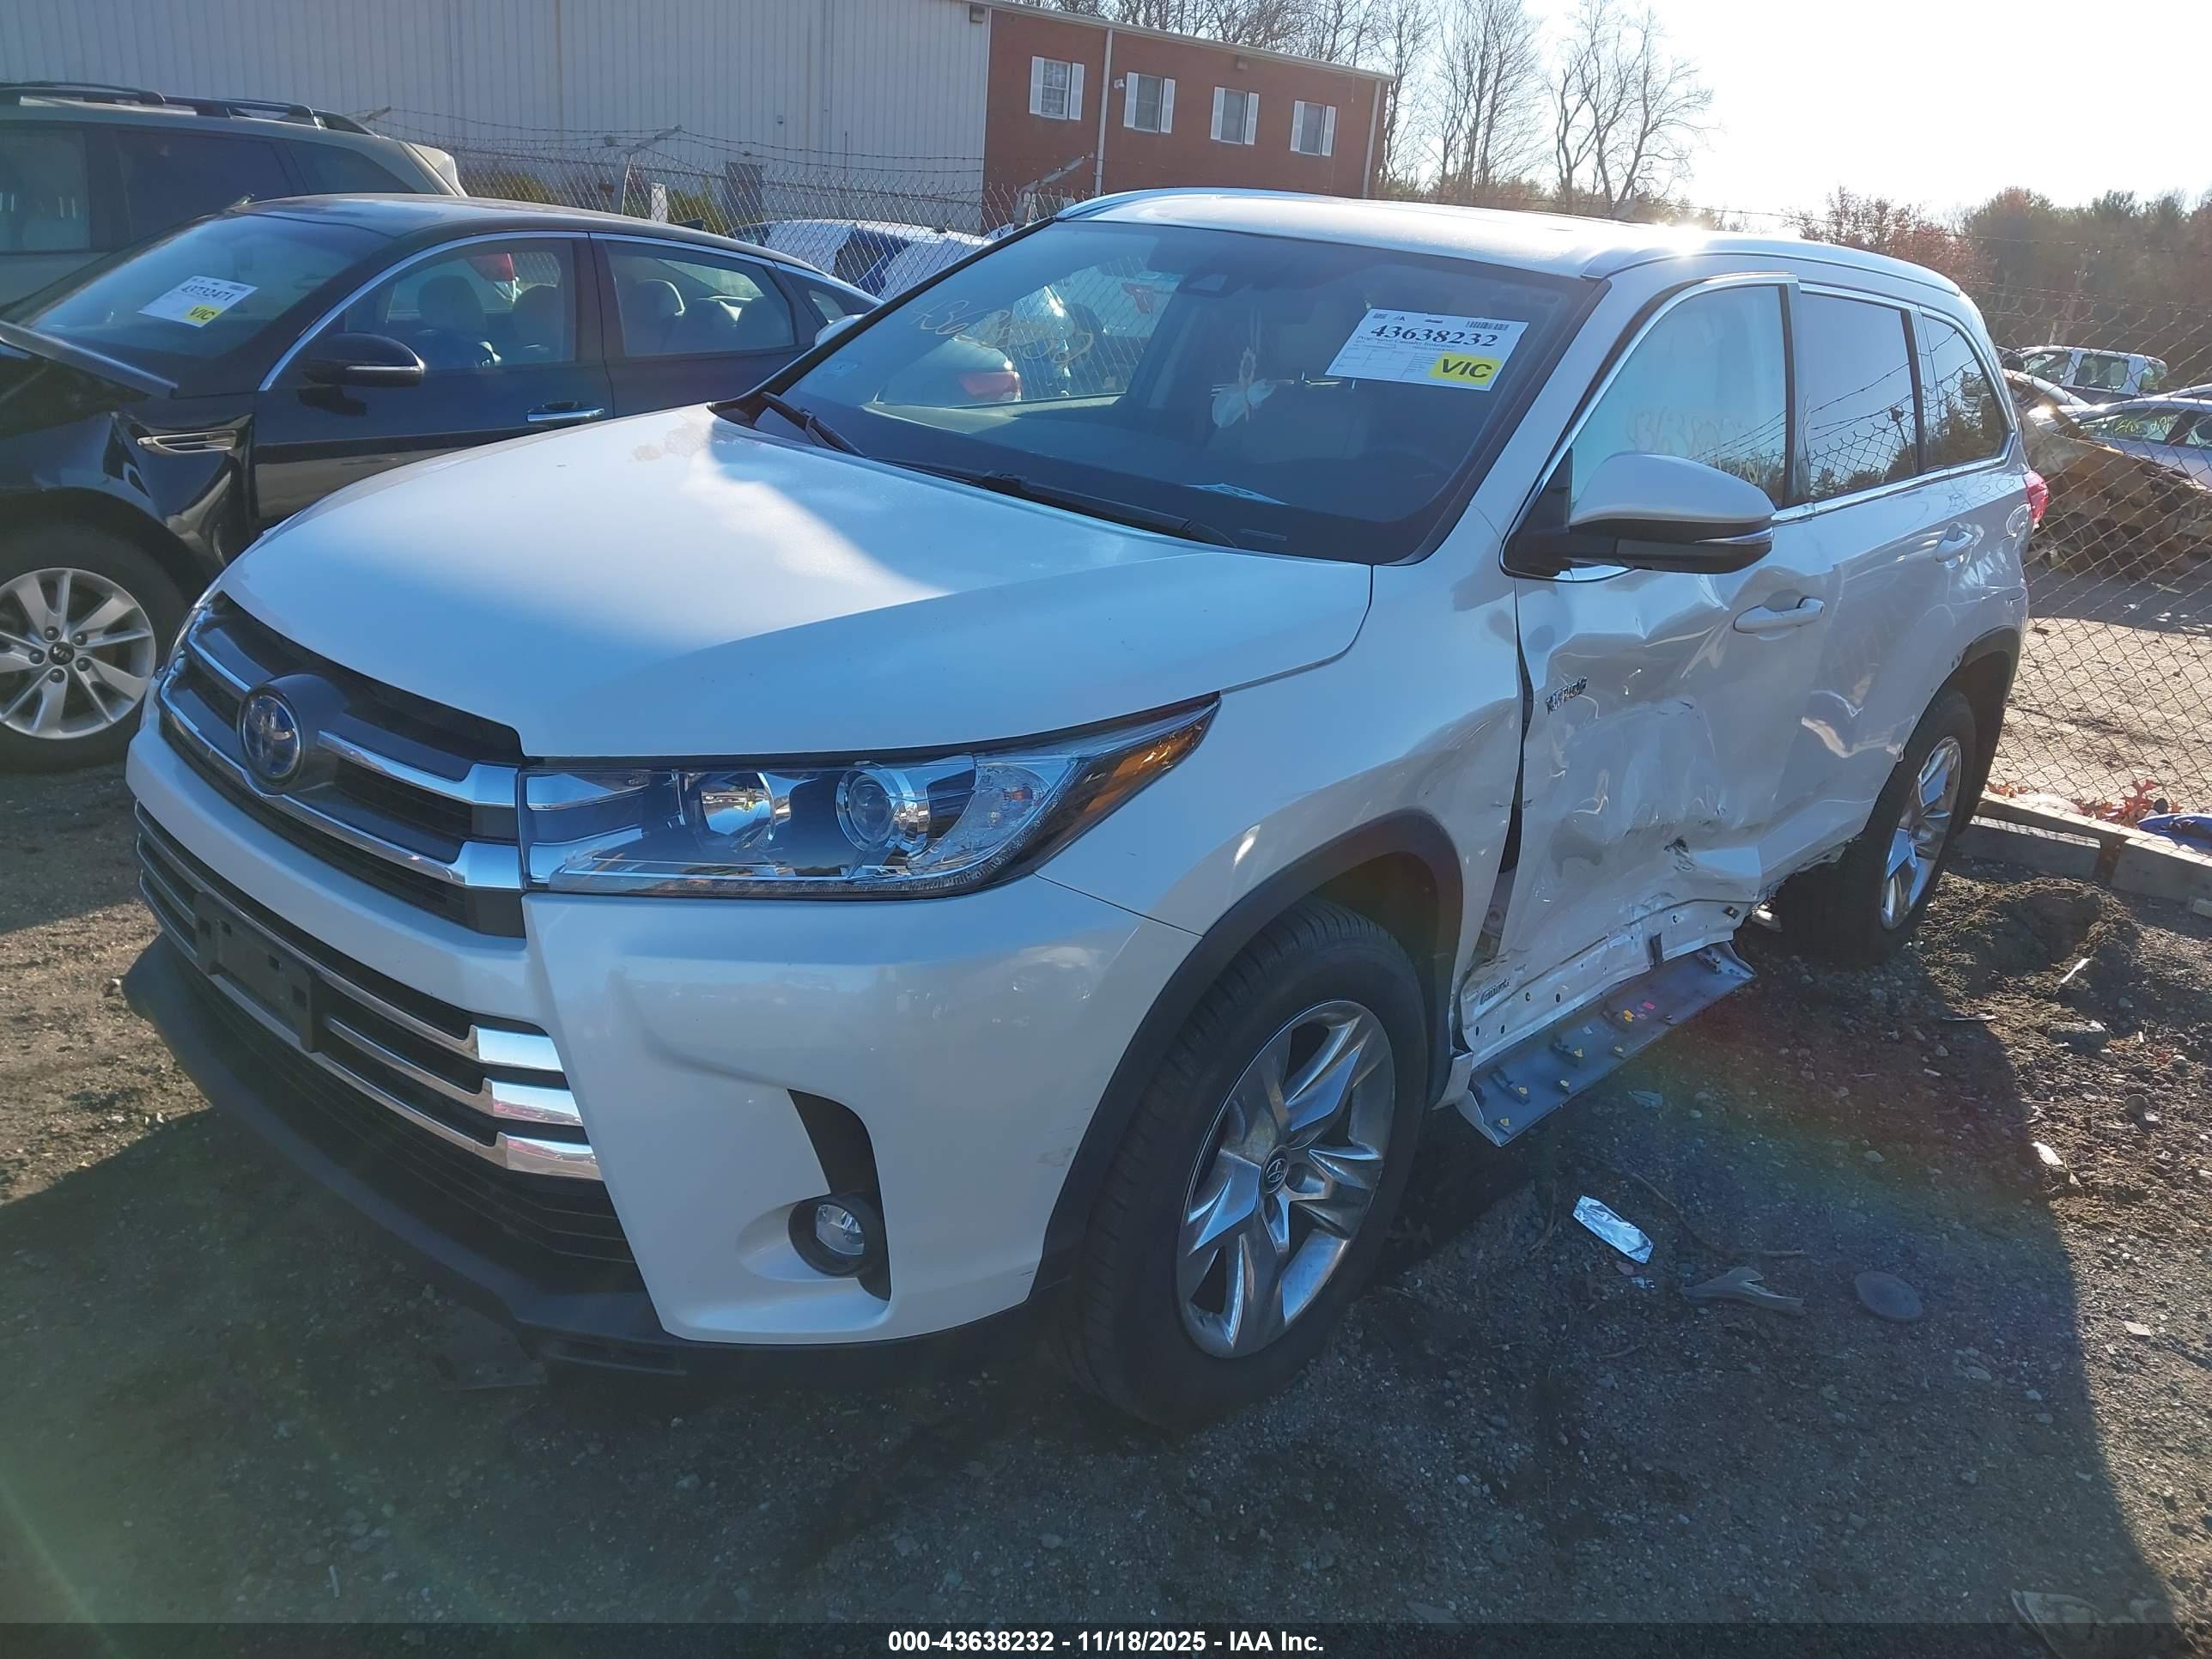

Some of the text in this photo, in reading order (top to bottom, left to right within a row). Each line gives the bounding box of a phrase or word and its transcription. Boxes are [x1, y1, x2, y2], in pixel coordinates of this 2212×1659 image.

[190, 307, 216, 320] VIC
[1371, 324, 1498, 347] 43638232
[1442, 358, 1492, 378] VIC
